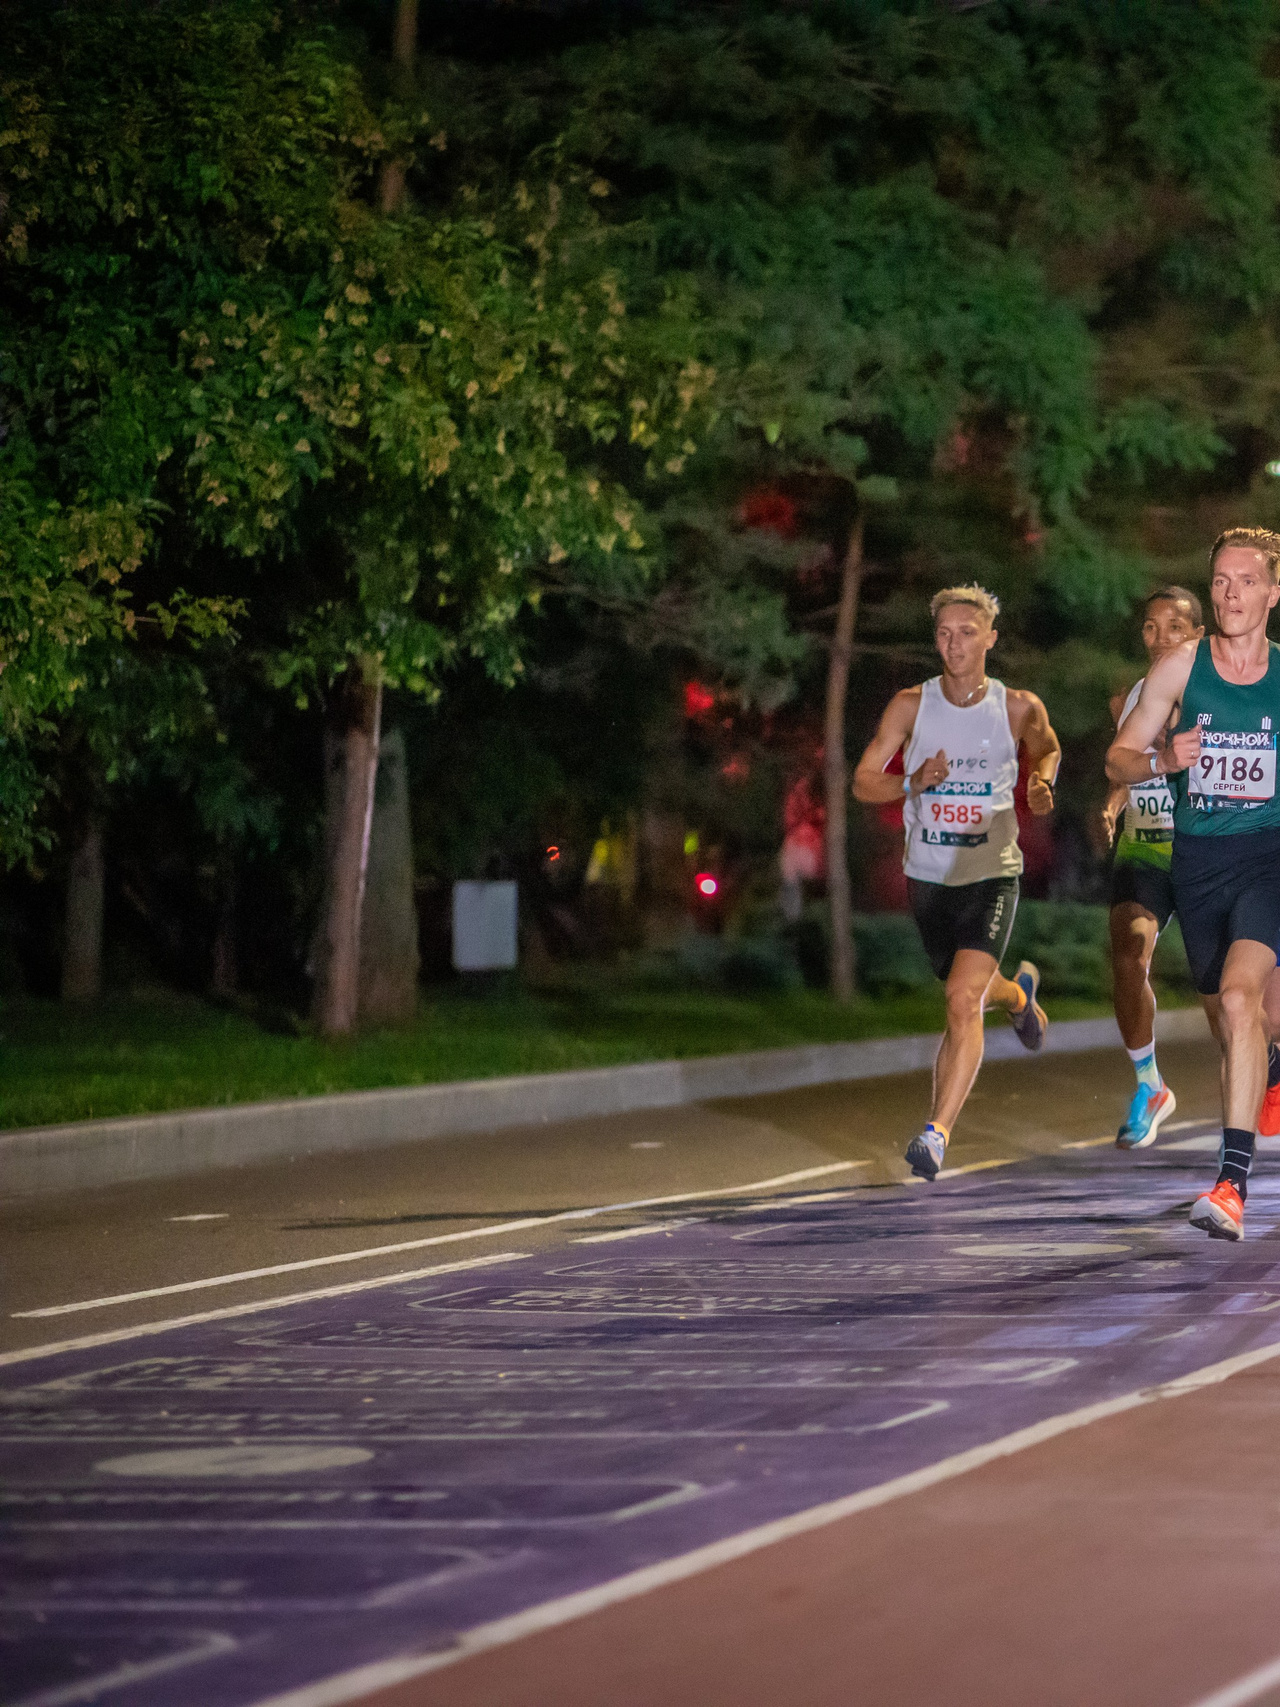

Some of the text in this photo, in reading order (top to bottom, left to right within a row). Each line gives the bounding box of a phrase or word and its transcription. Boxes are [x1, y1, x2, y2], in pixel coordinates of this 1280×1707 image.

[1200, 755, 1264, 782] 9186
[1213, 782, 1246, 792] СЕРГЕЙ
[930, 803, 983, 825] 9585
